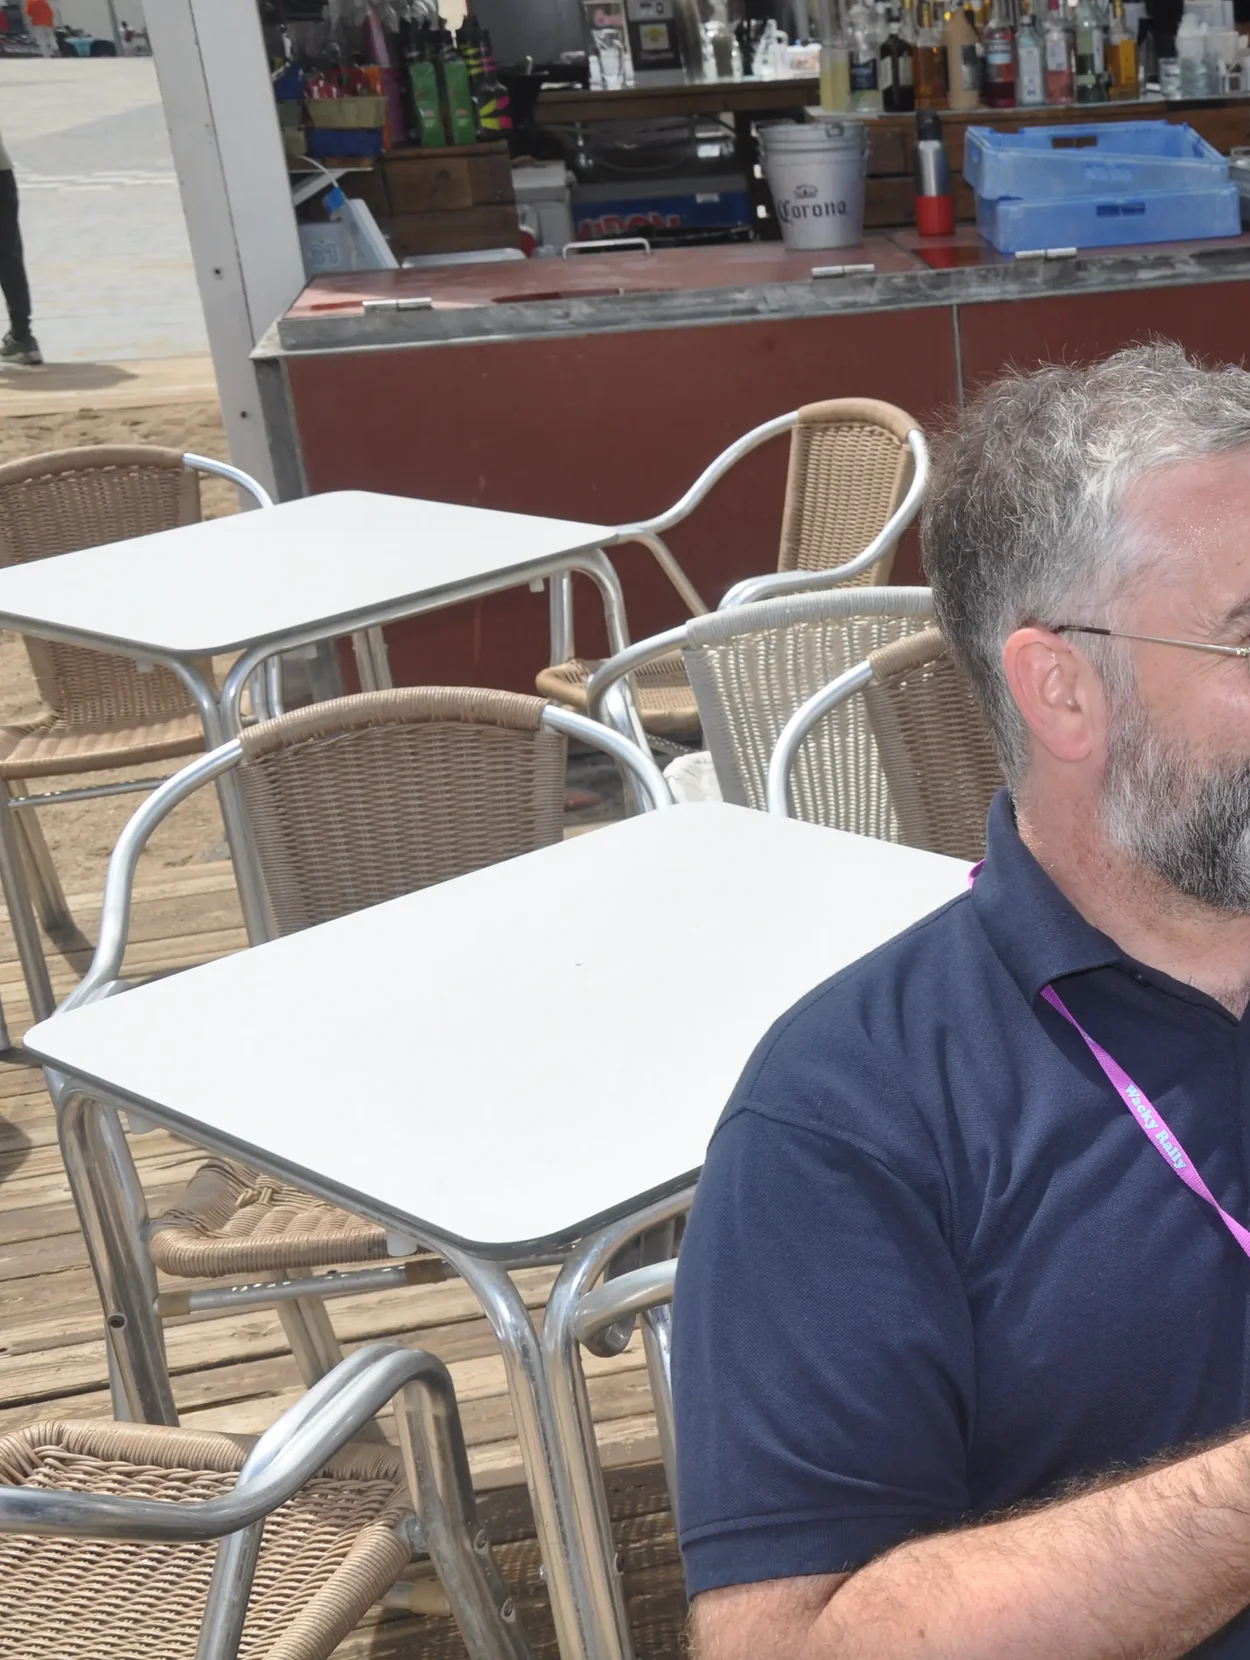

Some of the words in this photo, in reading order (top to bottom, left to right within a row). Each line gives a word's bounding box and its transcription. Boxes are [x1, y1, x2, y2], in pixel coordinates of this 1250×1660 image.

[777, 200, 846, 225] Corona
[1126, 1084, 1158, 1129] Wacky
[1155, 1129, 1187, 1168] Rally
